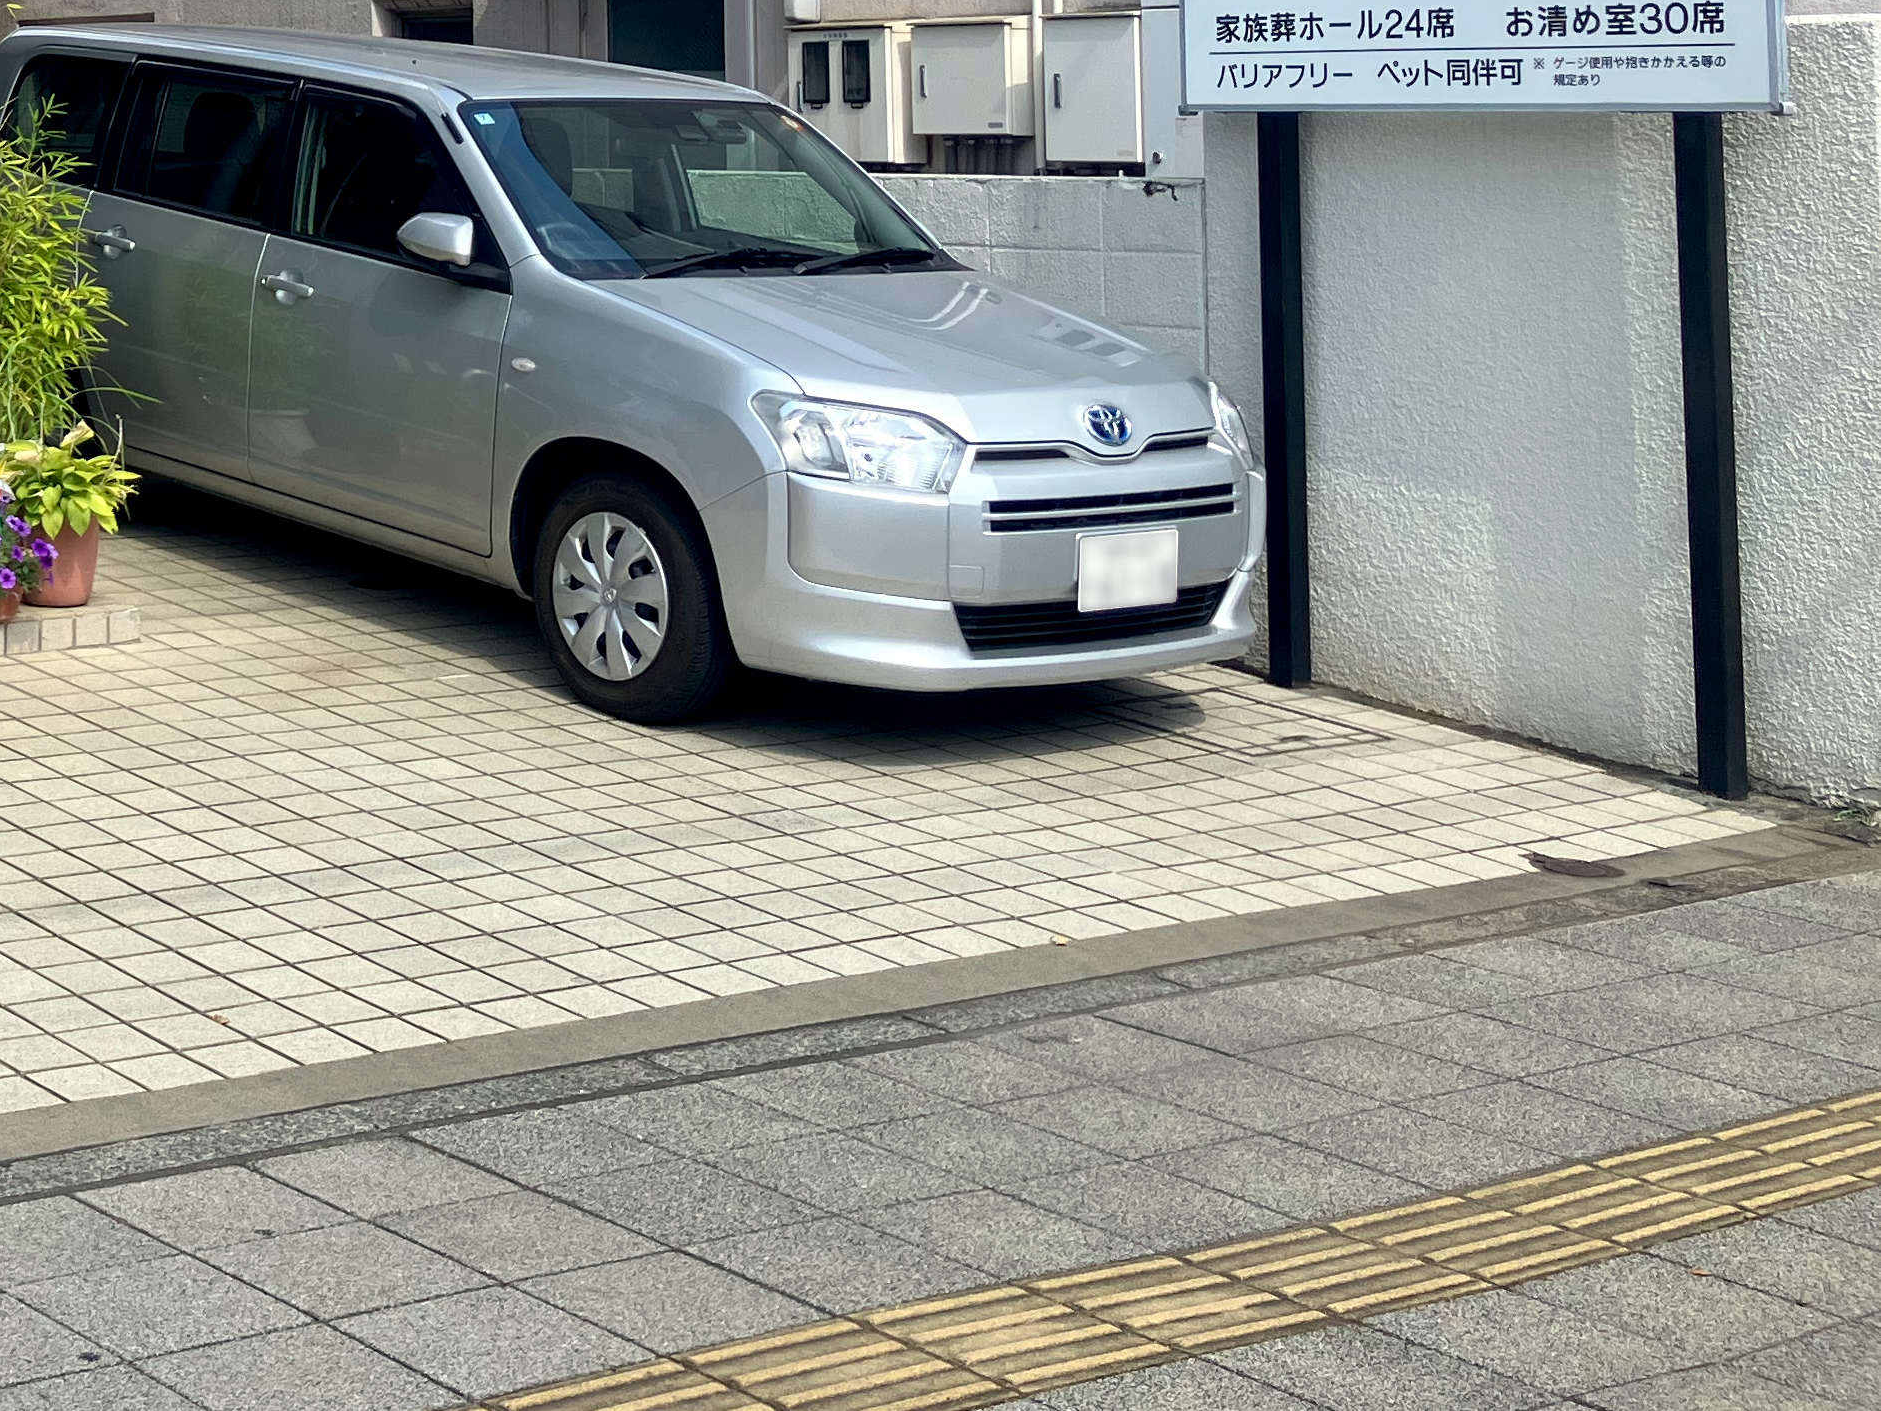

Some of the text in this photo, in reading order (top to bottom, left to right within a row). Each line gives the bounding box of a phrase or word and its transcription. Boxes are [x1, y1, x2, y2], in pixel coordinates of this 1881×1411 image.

[1216, 1, 1725, 44] 家族葬ホール24席 お清め室30席
[1217, 59, 1524, 89] バリアフリー ペット同伴可
[1552, 73, 1601, 87] 規定あり
